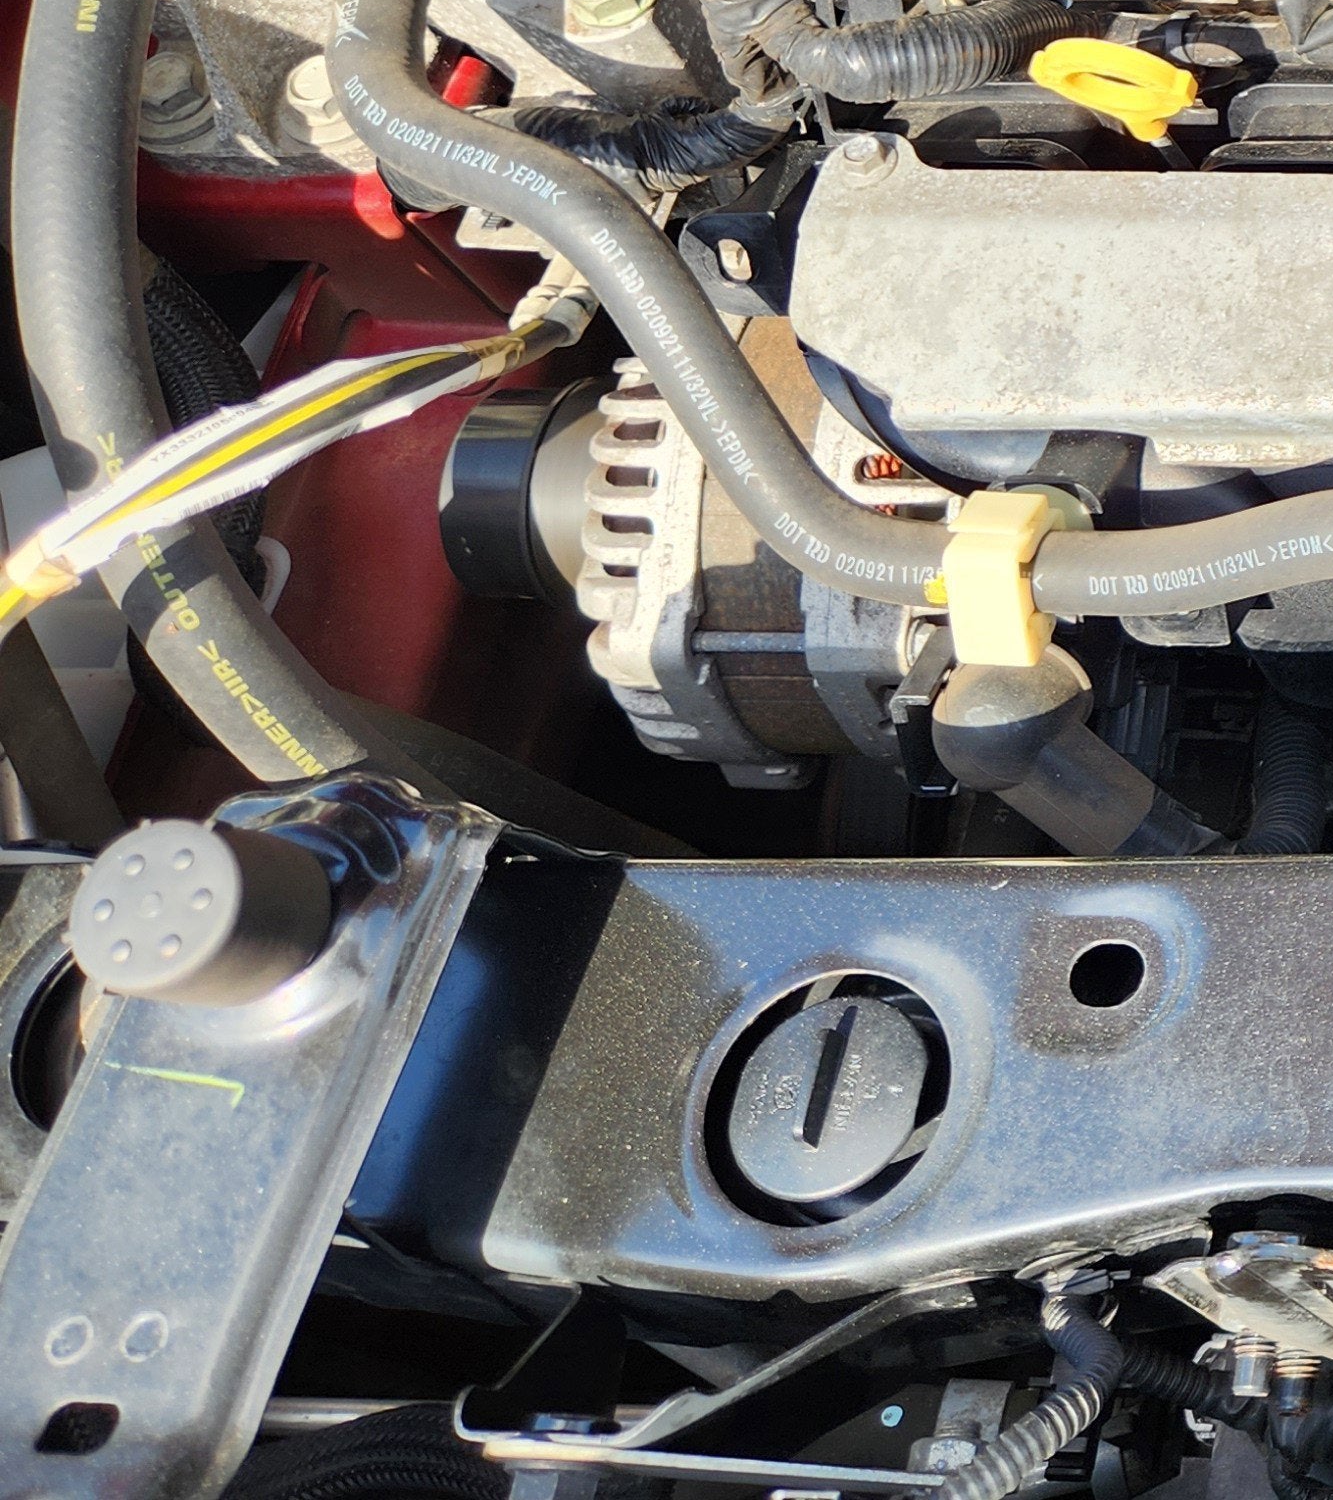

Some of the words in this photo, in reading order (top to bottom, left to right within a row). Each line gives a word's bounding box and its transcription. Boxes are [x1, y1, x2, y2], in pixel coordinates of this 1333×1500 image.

[344, 74, 369, 104] DOT
[386, 118, 442, 155] 020921
[502, 160, 568, 206] >EPDM<
[590, 227, 626, 264] DOT
[636, 295, 685, 358] 020921
[773, 511, 808, 546] DOT
[834, 551, 895, 583] 020921
[1088, 575, 1119, 596] DOT
[1153, 566, 1207, 594] 020921
[1207, 548, 1267, 581] 11/32VL
